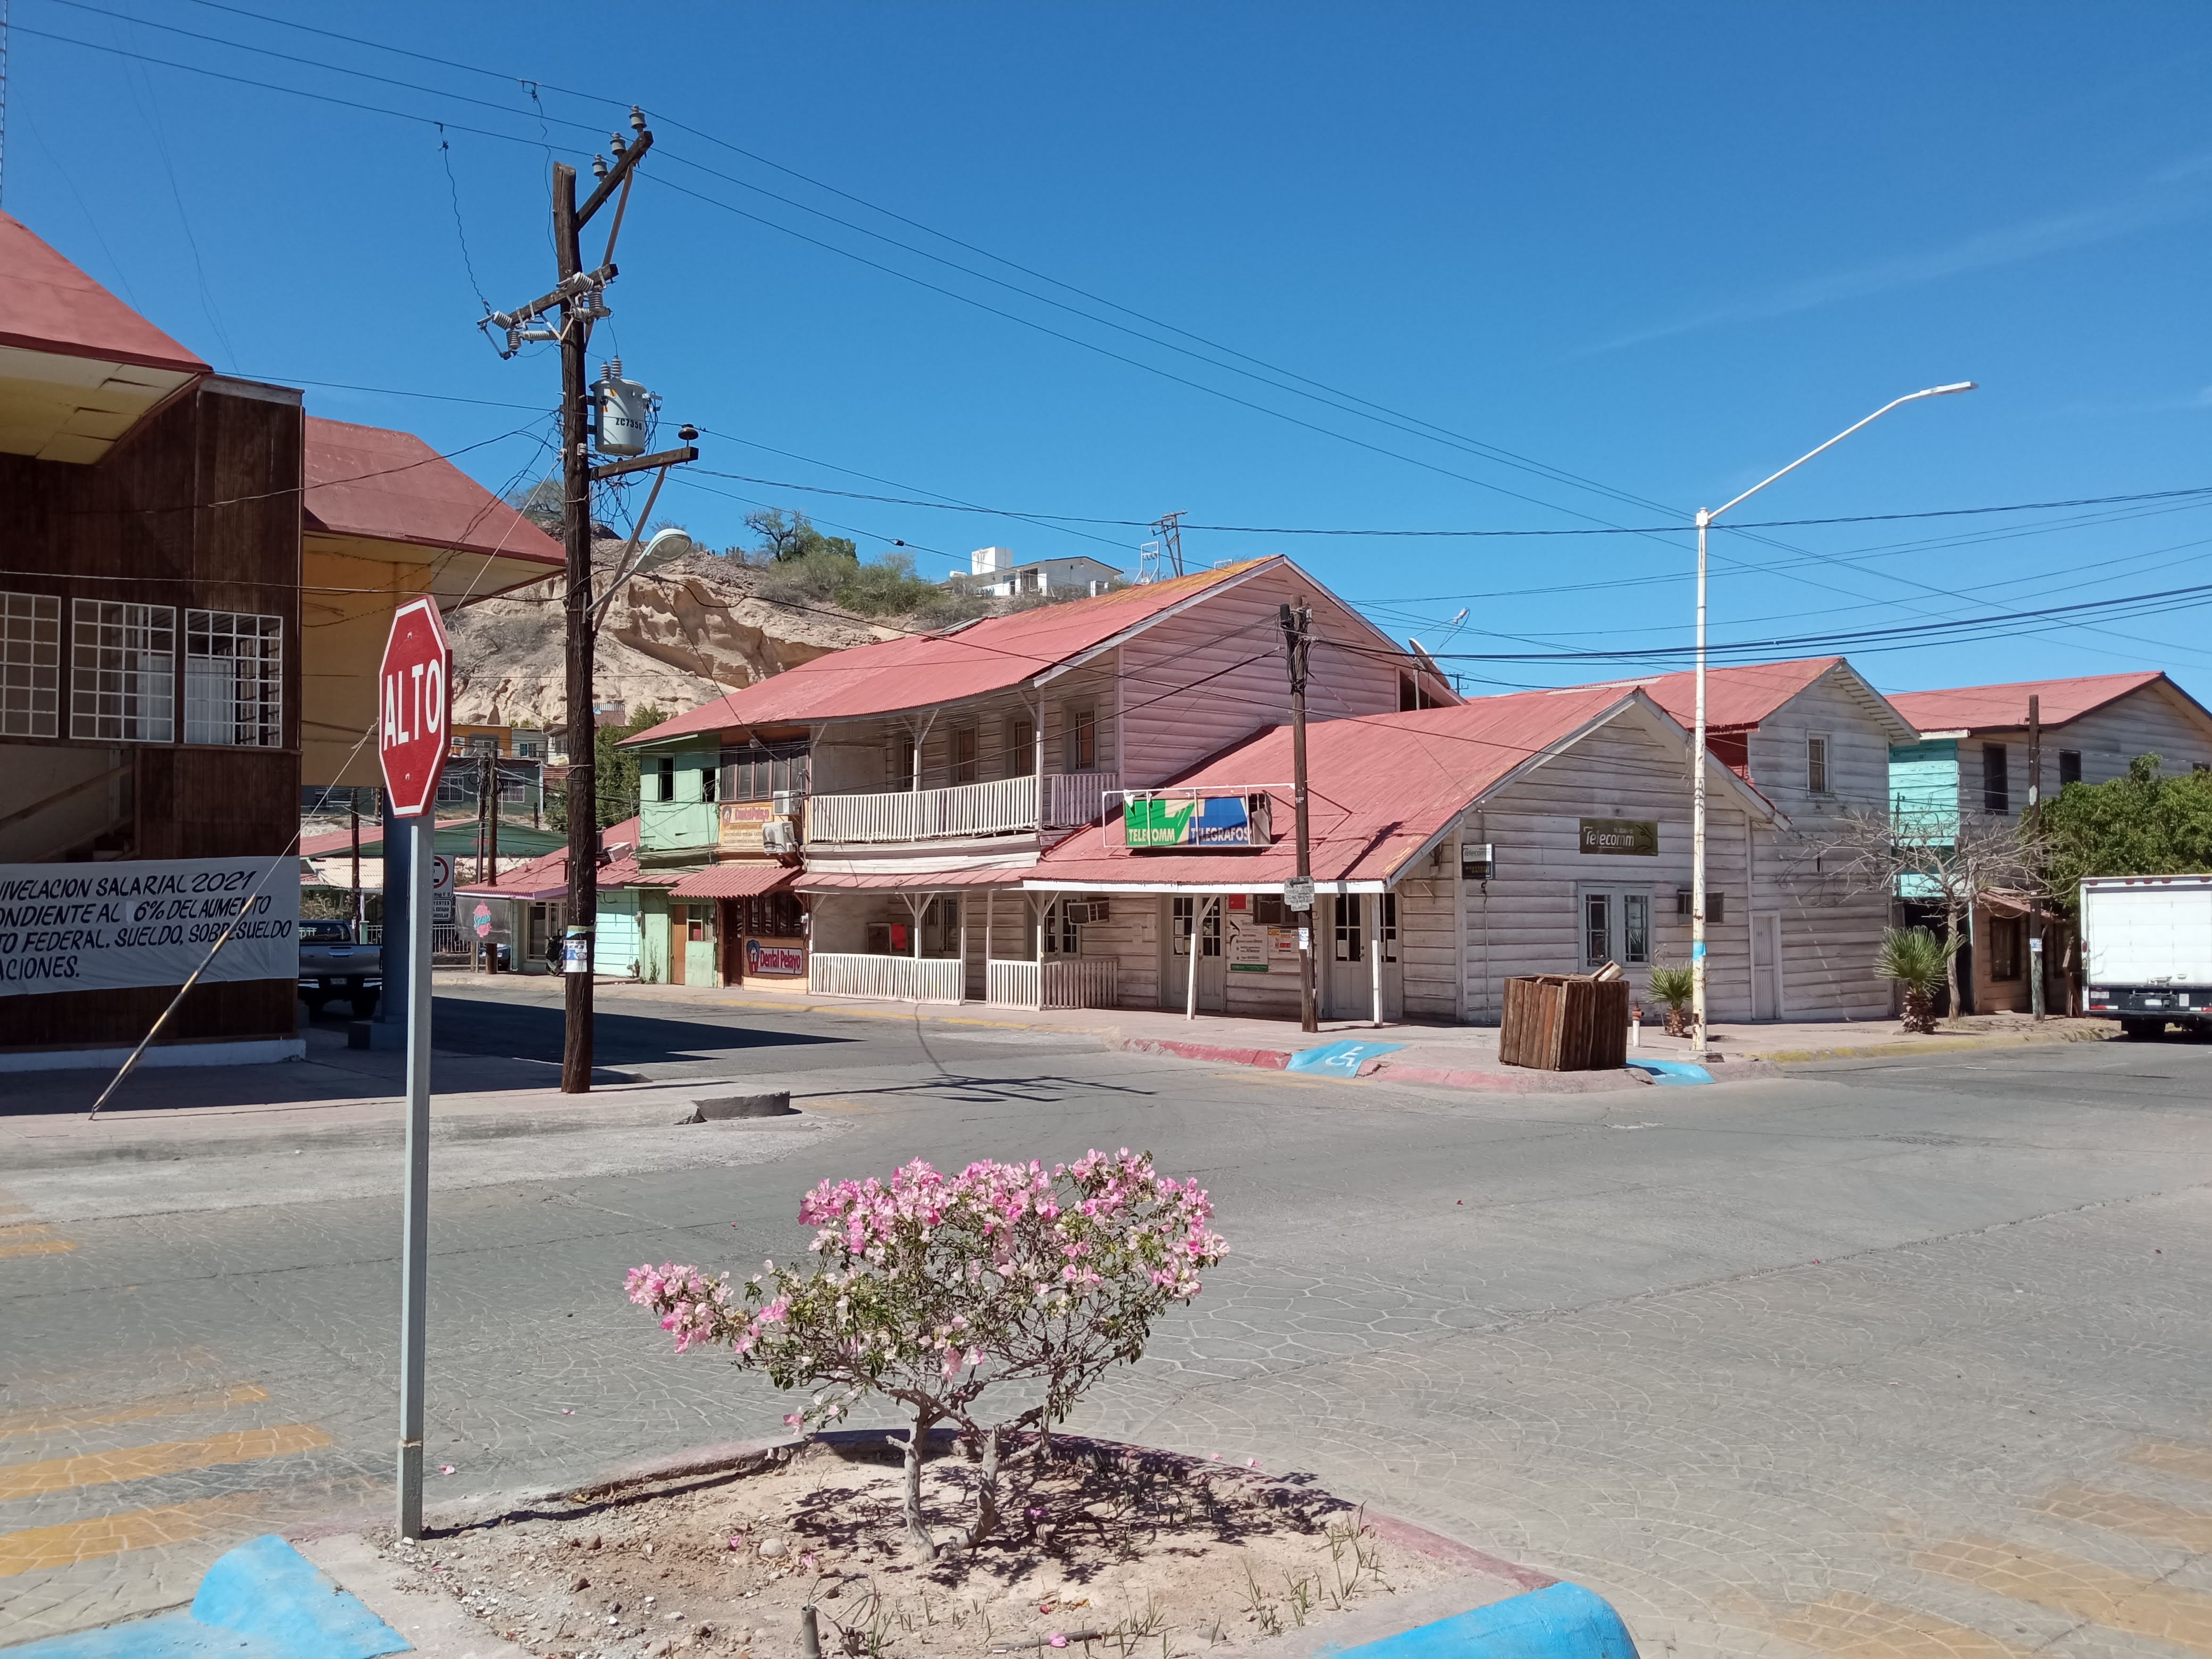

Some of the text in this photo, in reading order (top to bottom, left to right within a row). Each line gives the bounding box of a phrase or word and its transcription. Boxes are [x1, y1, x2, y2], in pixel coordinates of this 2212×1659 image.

[383, 659, 441, 751] ALTO
[1583, 826, 1634, 846] Telecomm
[96, 875, 187, 897] SALARIAL
[191, 870, 257, 892] 2021
[96, 903, 121, 924] AL
[133, 901, 167, 922] 6%
[22, 929, 110, 953] FEDERAL.
[115, 925, 184, 947] SUELDO,
[760, 949, 801, 974] Dental Pelayo
